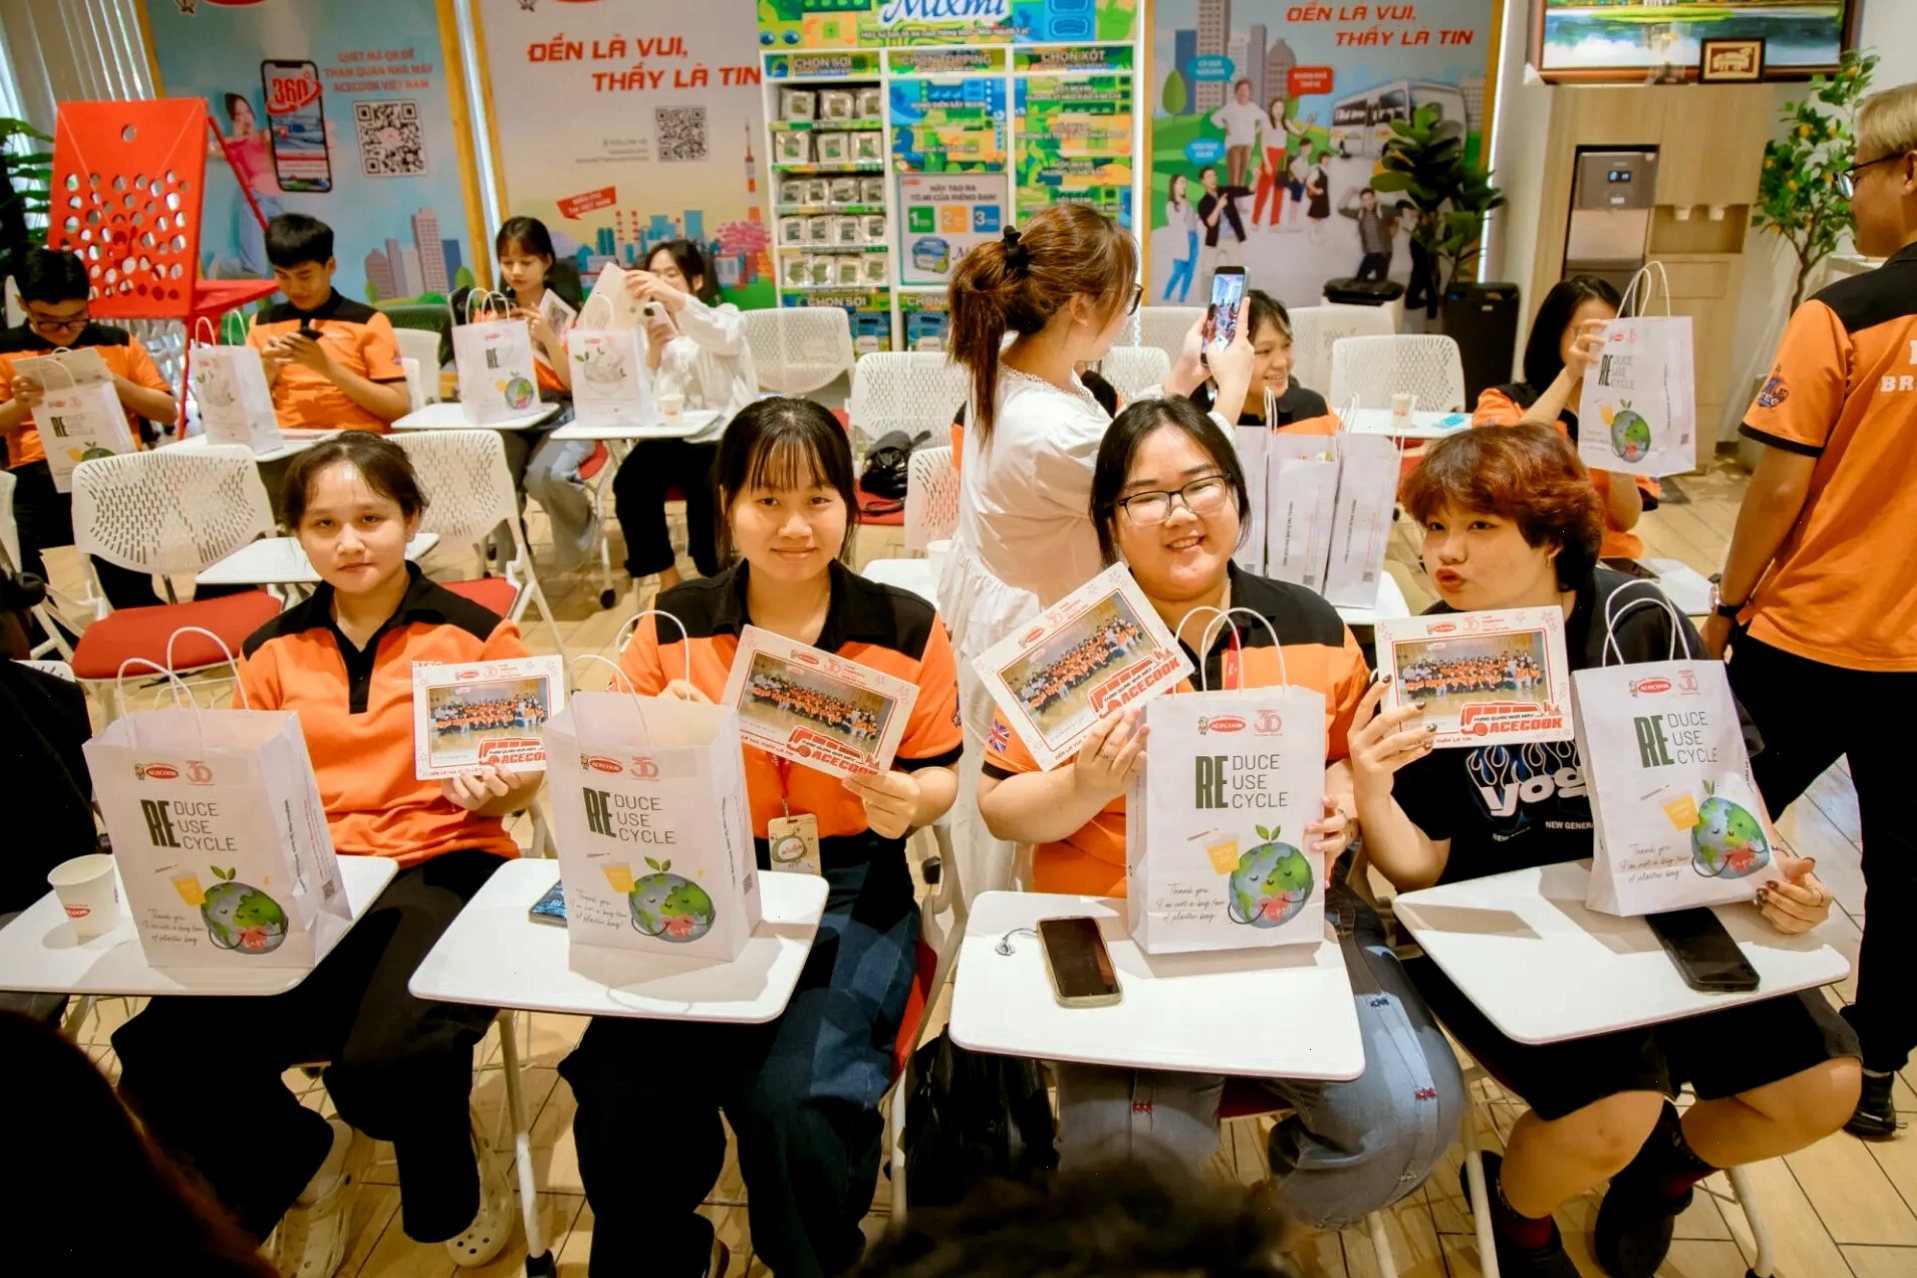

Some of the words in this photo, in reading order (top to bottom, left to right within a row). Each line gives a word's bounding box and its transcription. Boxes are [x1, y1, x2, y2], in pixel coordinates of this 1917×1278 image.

[1286, 0, 1332, 22] ĐẾN
[1338, 2, 1367, 21] LÀ
[1376, 5, 1416, 21] VUI,
[1336, 24, 1394, 46] THẤY
[1401, 26, 1430, 45] LÀ
[1439, 30, 1474, 45] TIN
[527, 32, 583, 63] ĐẾN
[592, 32, 626, 60] LÀ
[636, 36, 688, 58] VUI,
[936, 54, 992, 64] TOPPING
[592, 61, 664, 92] THẤY
[674, 62, 708, 89] LÀ
[718, 66, 761, 87] TIN
[974, 210, 986, 226] 3
[1121, 656, 1180, 704] ACECOOK
[1489, 717, 1563, 733] ACECOOK
[1634, 714, 1675, 768] RE
[1667, 712, 1708, 728] DUCE
[1672, 730, 1704, 746] USE
[1677, 748, 1718, 764] CYCLE
[1195, 755, 1228, 809] RE
[1232, 754, 1280, 770] DUCE
[1232, 774, 1267, 790] USE
[1232, 792, 1288, 809] CYCLE
[582, 787, 616, 838] RE
[614, 794, 662, 810] DUCE
[616, 812, 652, 827] USE
[140, 799, 181, 848] RE
[174, 800, 220, 817] DUCE
[176, 819, 212, 834] USE
[182, 836, 237, 851] CYCLE
[619, 830, 676, 844] CYCLE
